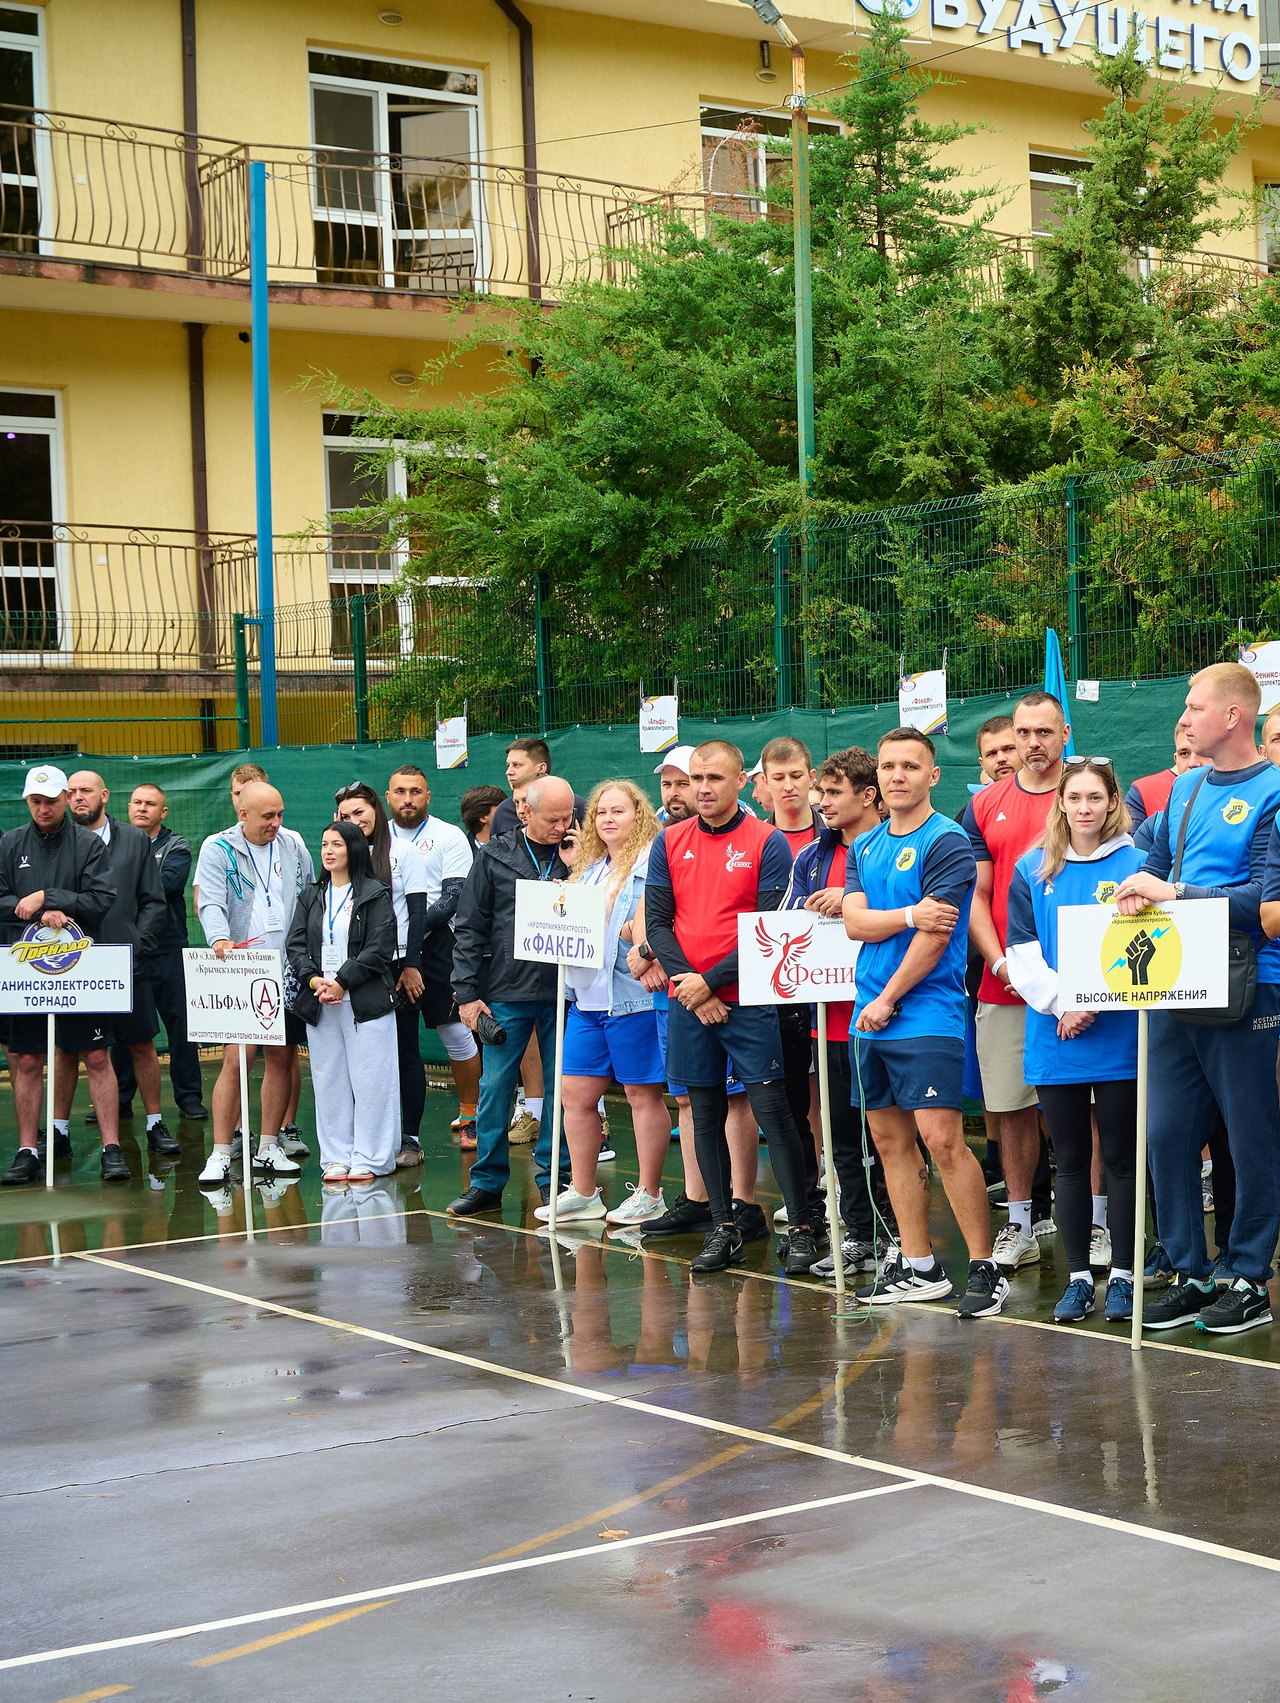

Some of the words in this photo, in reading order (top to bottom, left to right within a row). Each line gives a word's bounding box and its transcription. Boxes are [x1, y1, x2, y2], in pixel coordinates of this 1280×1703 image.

[527, 921, 592, 934] «КРОПОТКИНЭЛЕКТРОСЕТЬ»
[523, 933, 595, 960] «ФАКЕЛ»
[188, 951, 198, 960] АО
[247, 951, 275, 963] Кубани»
[195, 964, 270, 976] «Крымскэлектросеть»
[24, 996, 77, 1008] ТОРНАДО
[191, 994, 248, 1010] «АЛЬФА»
[1076, 991, 1128, 1004] ВЫСОКИЕ
[1131, 989, 1207, 1002] НАПРЯЖЕНИЯ
